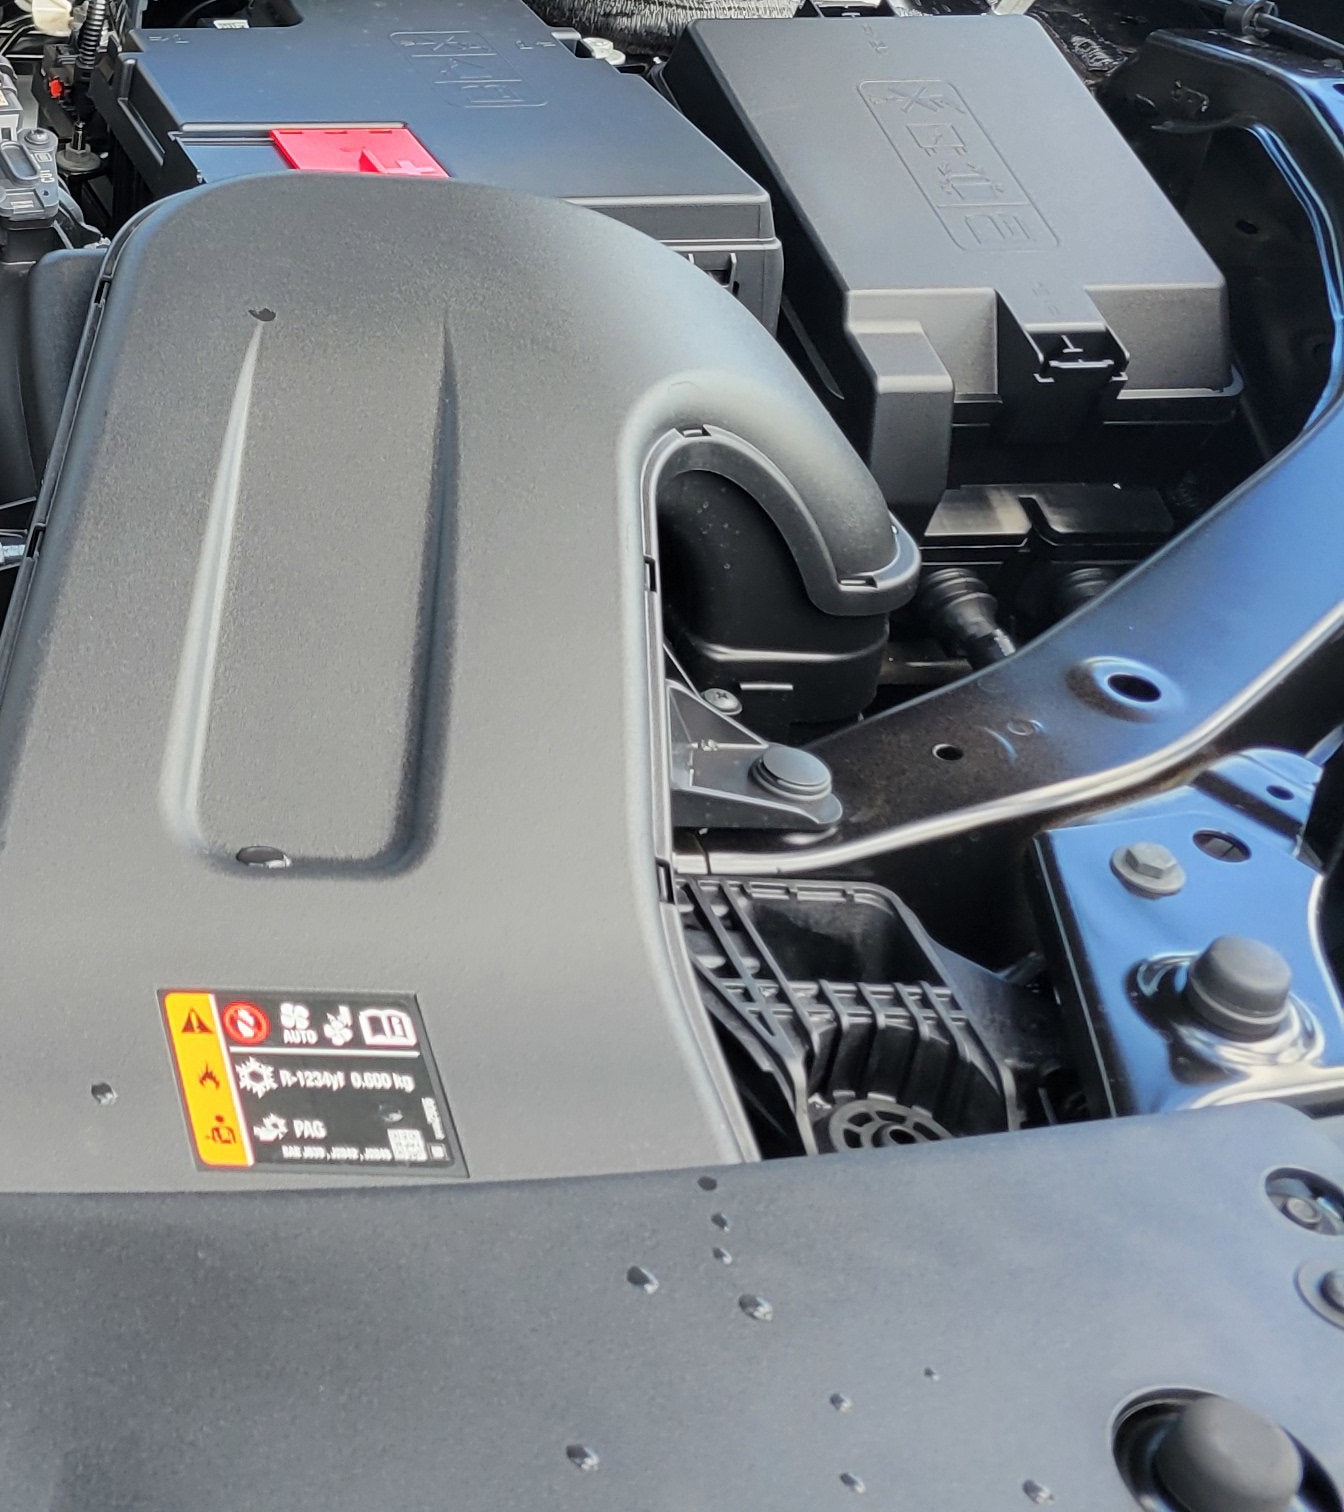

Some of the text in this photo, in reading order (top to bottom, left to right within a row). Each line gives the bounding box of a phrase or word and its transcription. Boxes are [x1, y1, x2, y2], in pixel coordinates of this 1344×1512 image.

[283, 1029, 319, 1045] AUTO
[393, 1073, 416, 1093] kg
[293, 1119, 327, 1139] PAG
